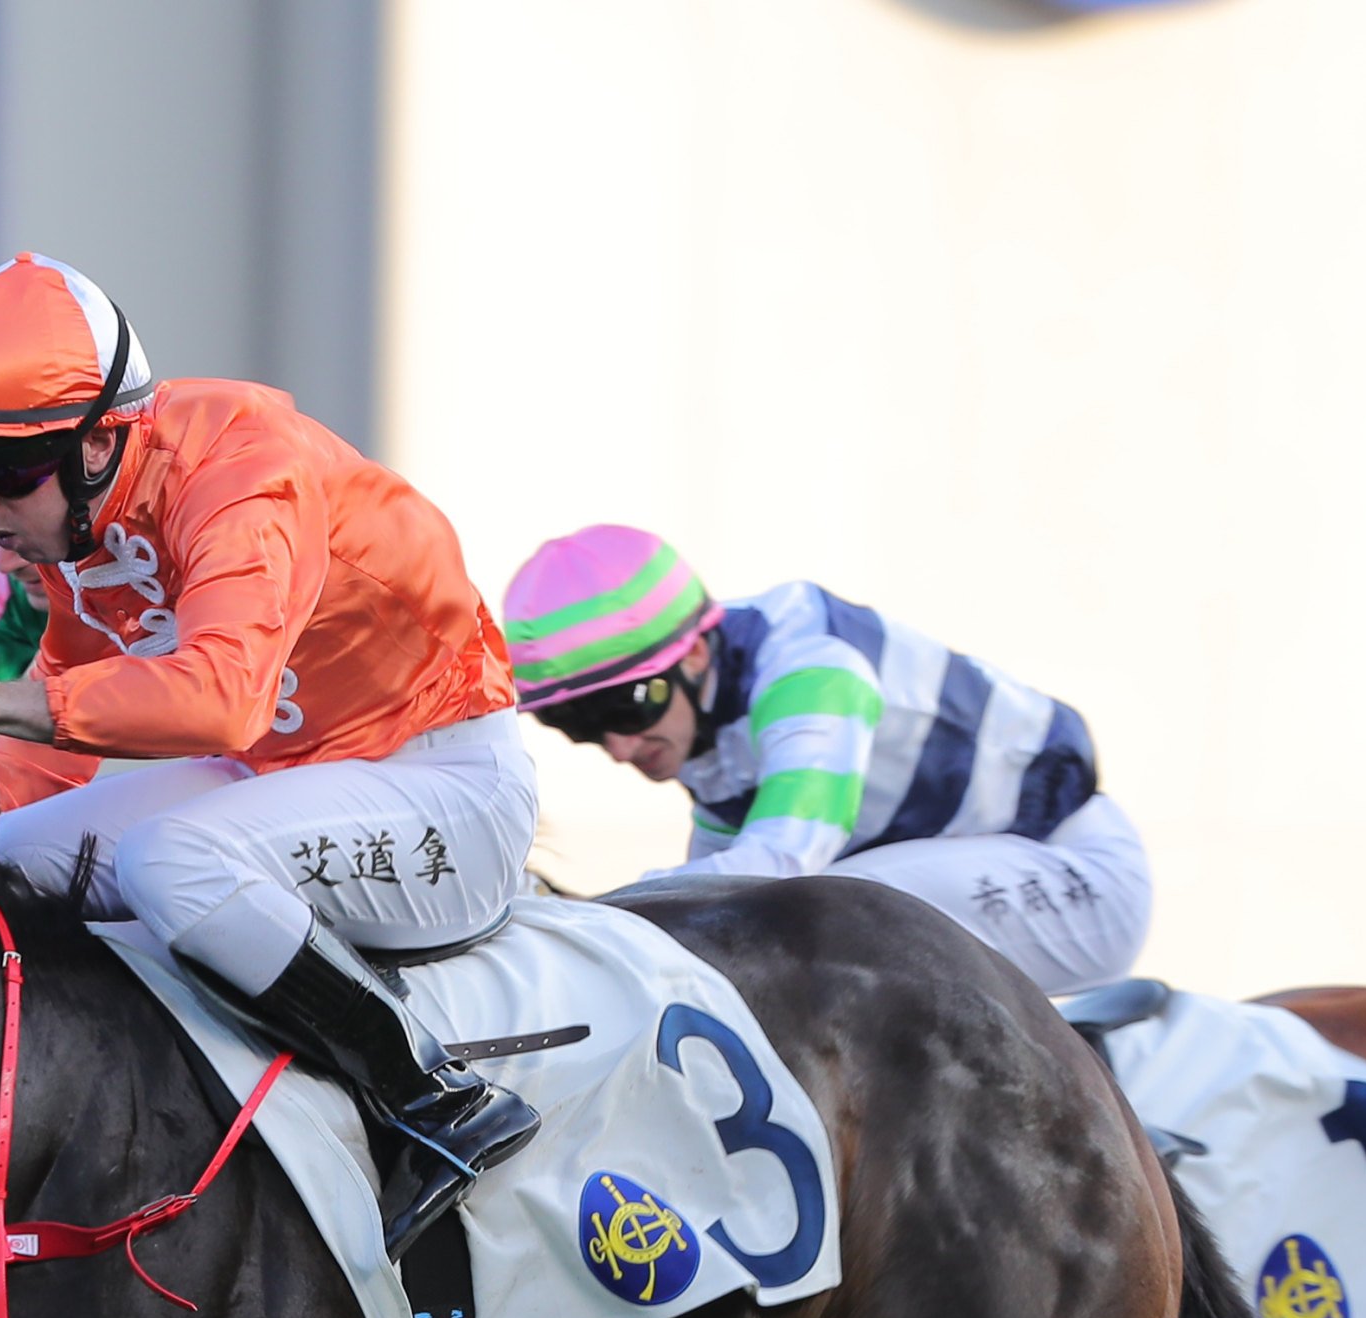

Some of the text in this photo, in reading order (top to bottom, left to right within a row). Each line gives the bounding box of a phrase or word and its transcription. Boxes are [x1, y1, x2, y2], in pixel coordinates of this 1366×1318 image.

[291, 826, 457, 890] 艾道拿
[657, 1004, 825, 1288] 3
